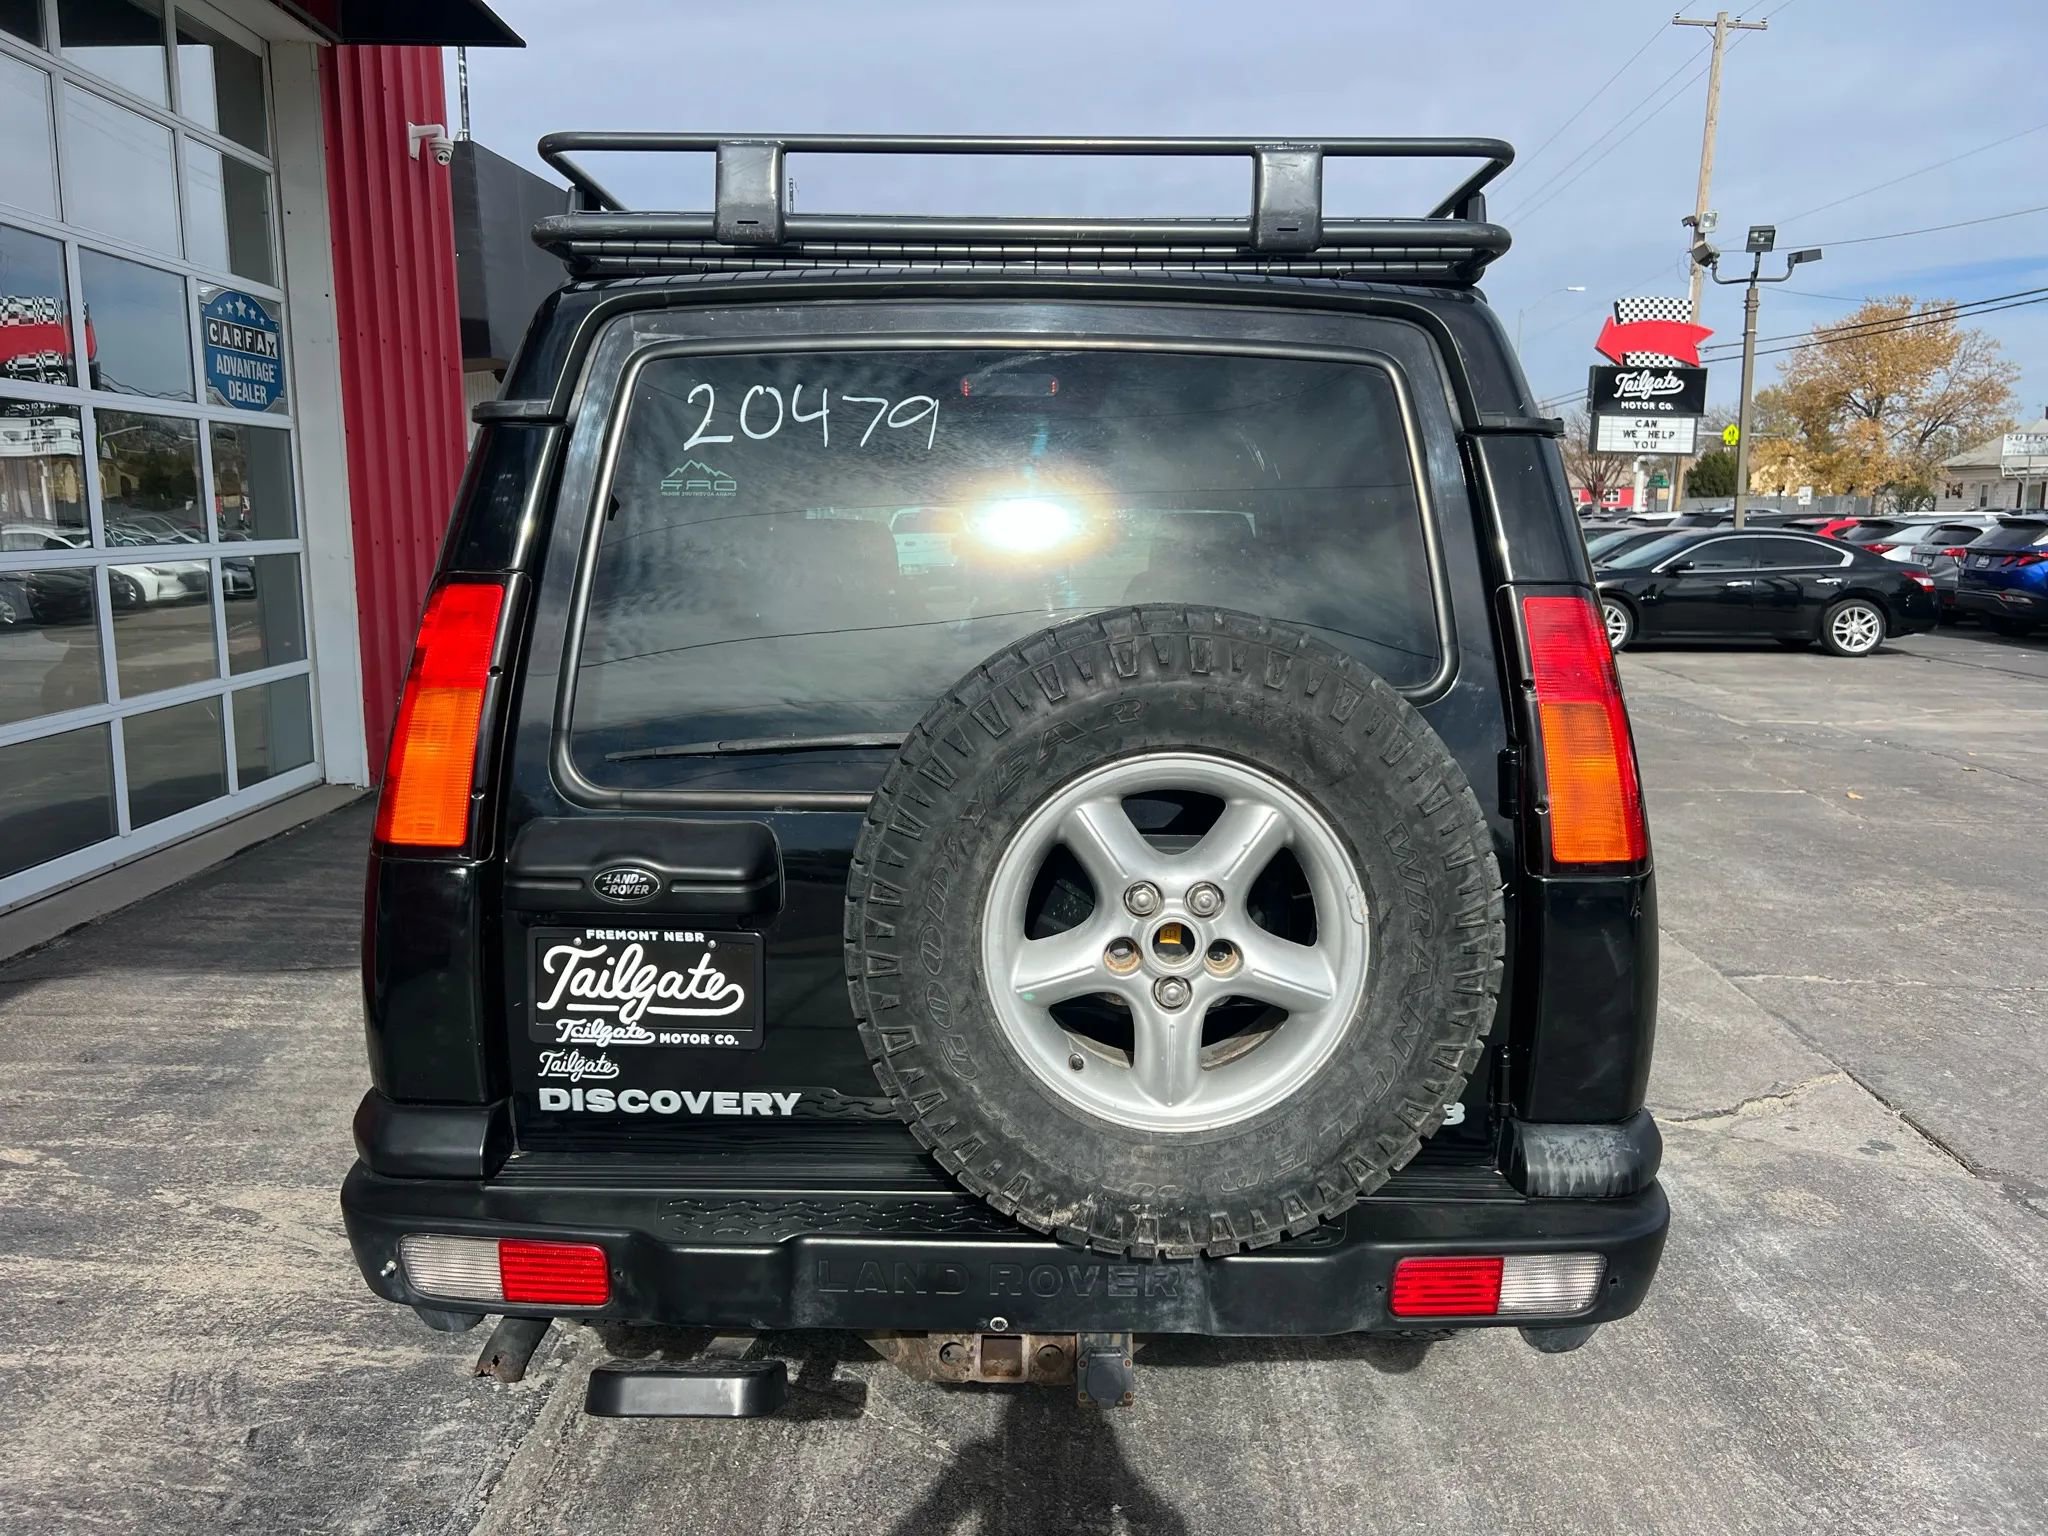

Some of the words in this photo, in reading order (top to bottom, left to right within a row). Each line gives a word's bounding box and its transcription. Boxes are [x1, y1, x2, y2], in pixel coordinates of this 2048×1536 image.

[208, 321, 278, 358] CARFAX
[216, 355, 276, 384] ADVANTAGE
[228, 379, 268, 406] DEALER
[1613, 369, 1685, 400] Tailgate
[684, 383, 940, 450] 20479
[1621, 401, 1655, 410] MOTOR
[1623, 429, 1638, 439] WE
[1647, 430, 1676, 439] HELP
[1635, 419, 1658, 429] CAN
[1633, 440, 1657, 449] YOU
[605, 873, 640, 884] LAND
[608, 884, 650, 895] ROVER
[585, 929, 659, 941] FREMONT
[663, 931, 705, 943] NEBR
[536, 943, 745, 1024] Tailgate
[555, 1018, 656, 1047] Tailgate
[659, 1033, 710, 1046] MOTOR
[714, 1034, 740, 1046] CO.
[537, 1049, 620, 1082] Tailgate
[538, 1087, 802, 1116] DISCOVERY
[817, 1259, 970, 1296] LAND
[989, 1262, 1180, 1298] ROVER
